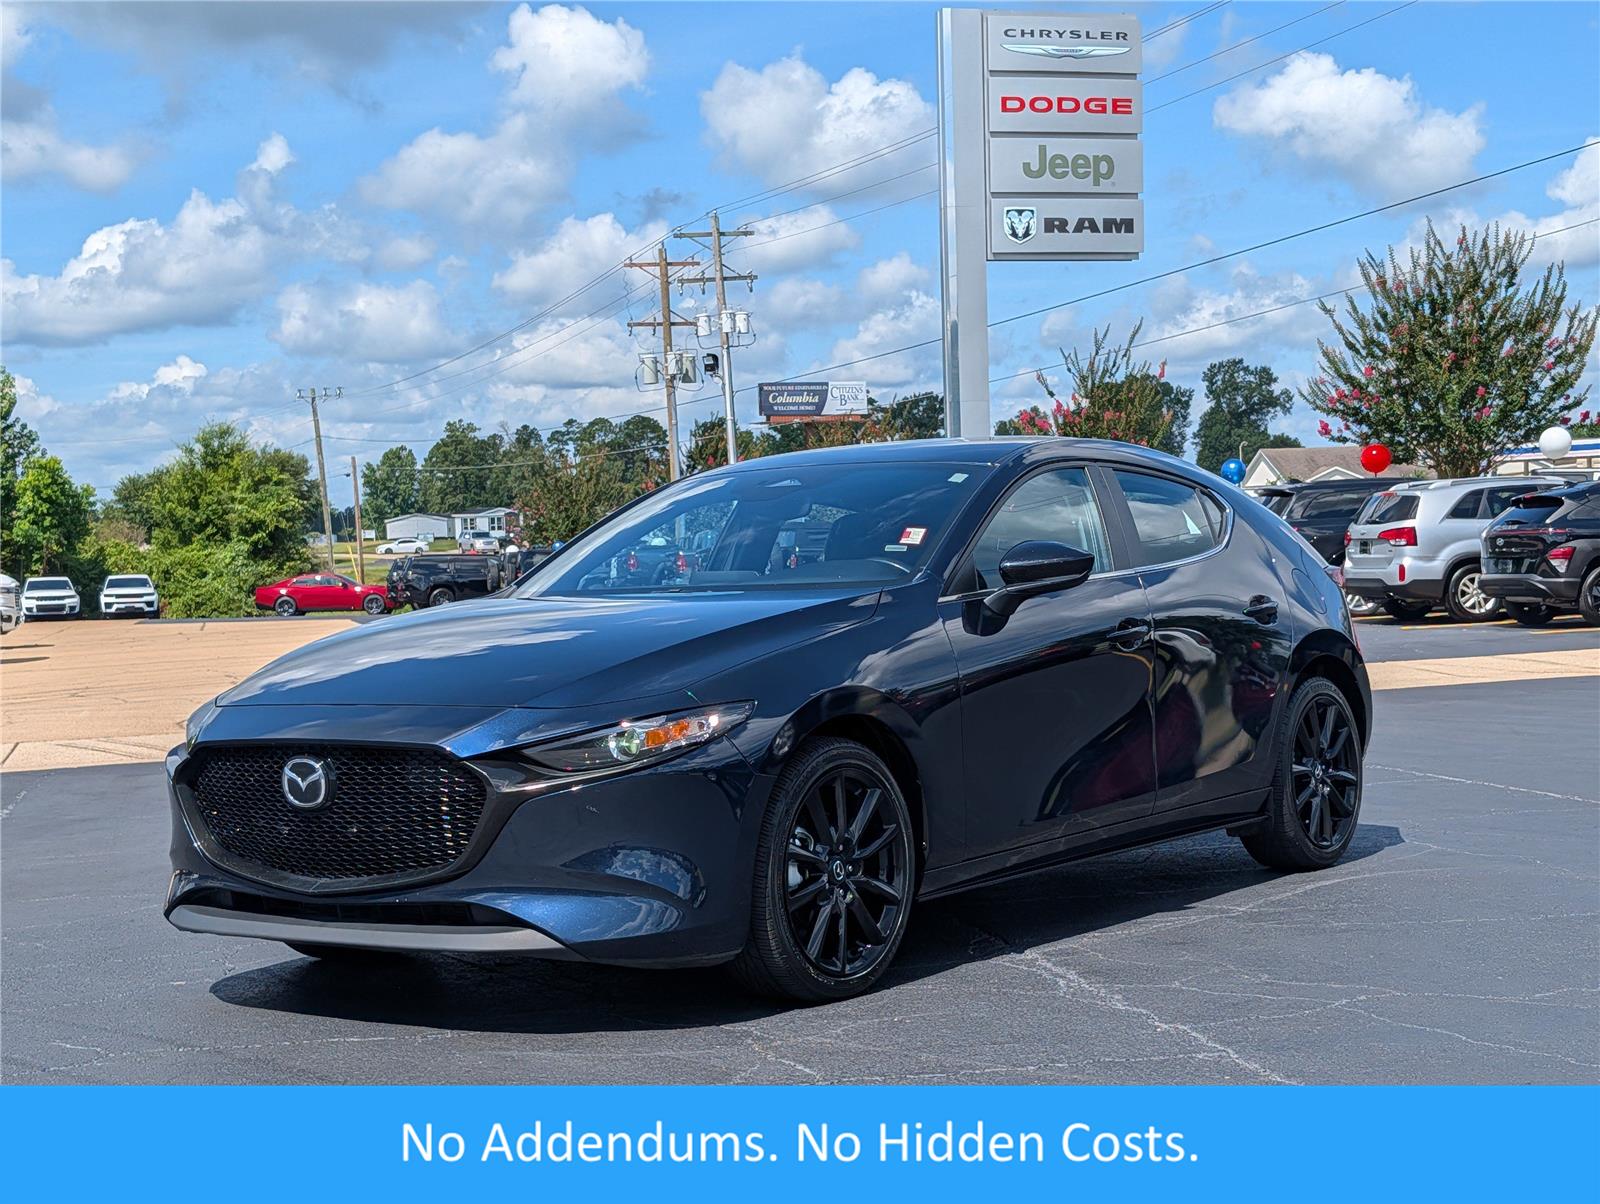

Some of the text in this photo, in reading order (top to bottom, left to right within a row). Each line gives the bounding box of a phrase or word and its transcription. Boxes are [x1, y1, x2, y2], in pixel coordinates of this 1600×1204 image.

[1003, 28, 1128, 41] CHRYSLER
[1000, 96, 1133, 115] DODGE
[1022, 144, 1115, 187] Jeep
[1043, 217, 1135, 234] RAM
[768, 391, 819, 404] Columbia
[830, 386, 863, 399] CITIZENS
[840, 393, 860, 407] BANK
